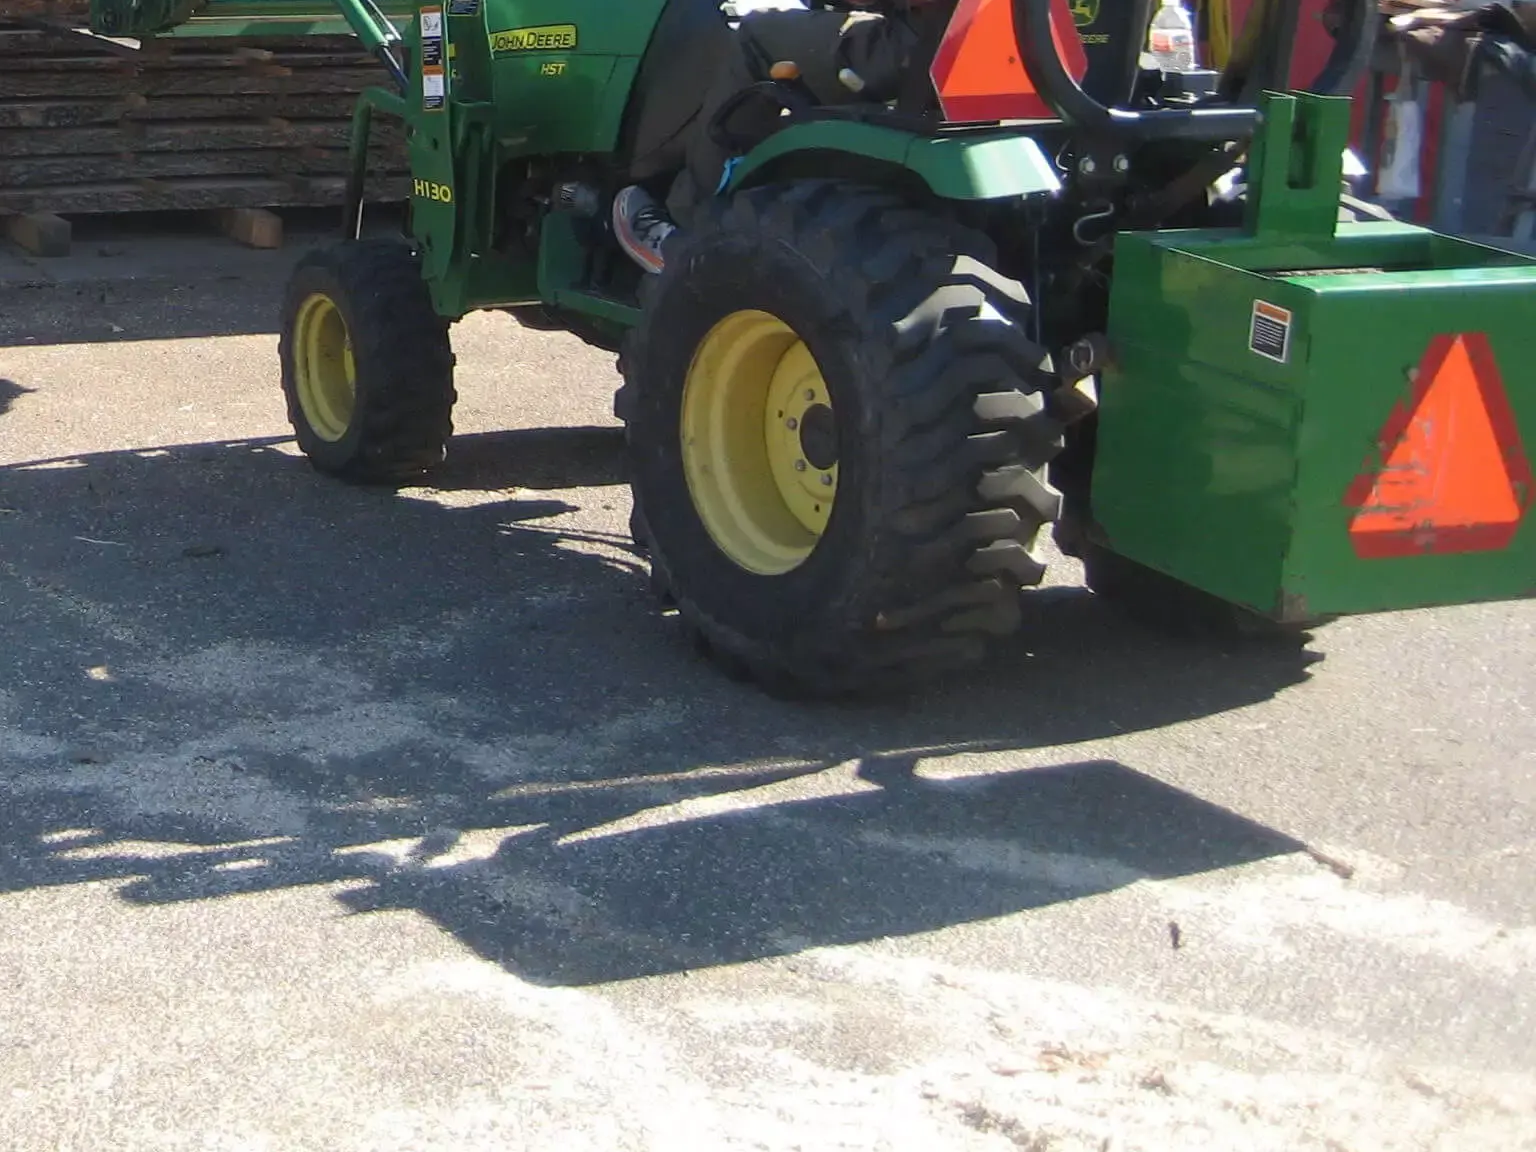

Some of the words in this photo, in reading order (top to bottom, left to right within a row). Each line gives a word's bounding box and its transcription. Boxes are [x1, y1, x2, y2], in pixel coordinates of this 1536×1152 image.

[491, 34, 524, 50] JOHN
[526, 31, 571, 47] DEERE
[540, 62, 566, 76] HST
[414, 179, 452, 203] H130
